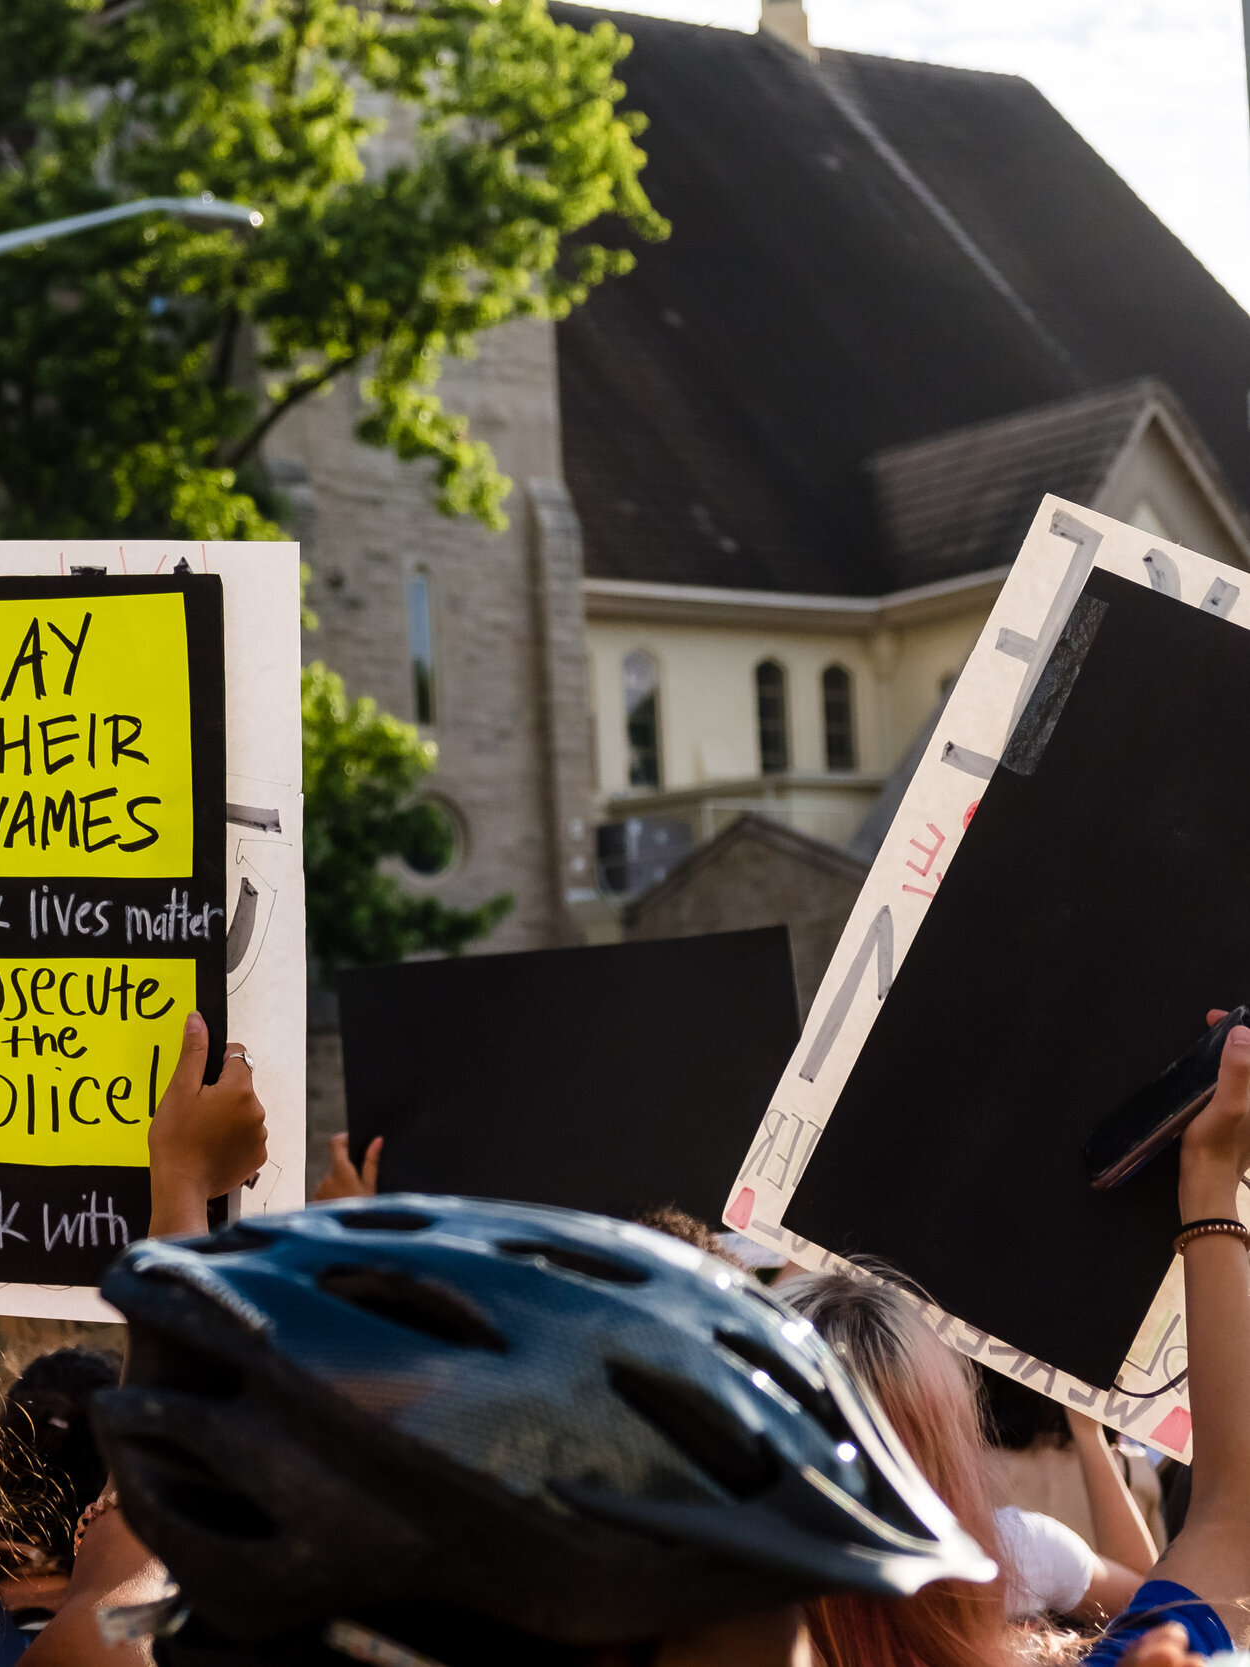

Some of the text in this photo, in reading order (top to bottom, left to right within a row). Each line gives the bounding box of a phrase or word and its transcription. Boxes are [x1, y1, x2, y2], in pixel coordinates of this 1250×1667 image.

[29, 885, 113, 937] lives
[124, 887, 224, 944] matter
[1, 1025, 88, 1058] the
[43, 1190, 130, 1252] with
